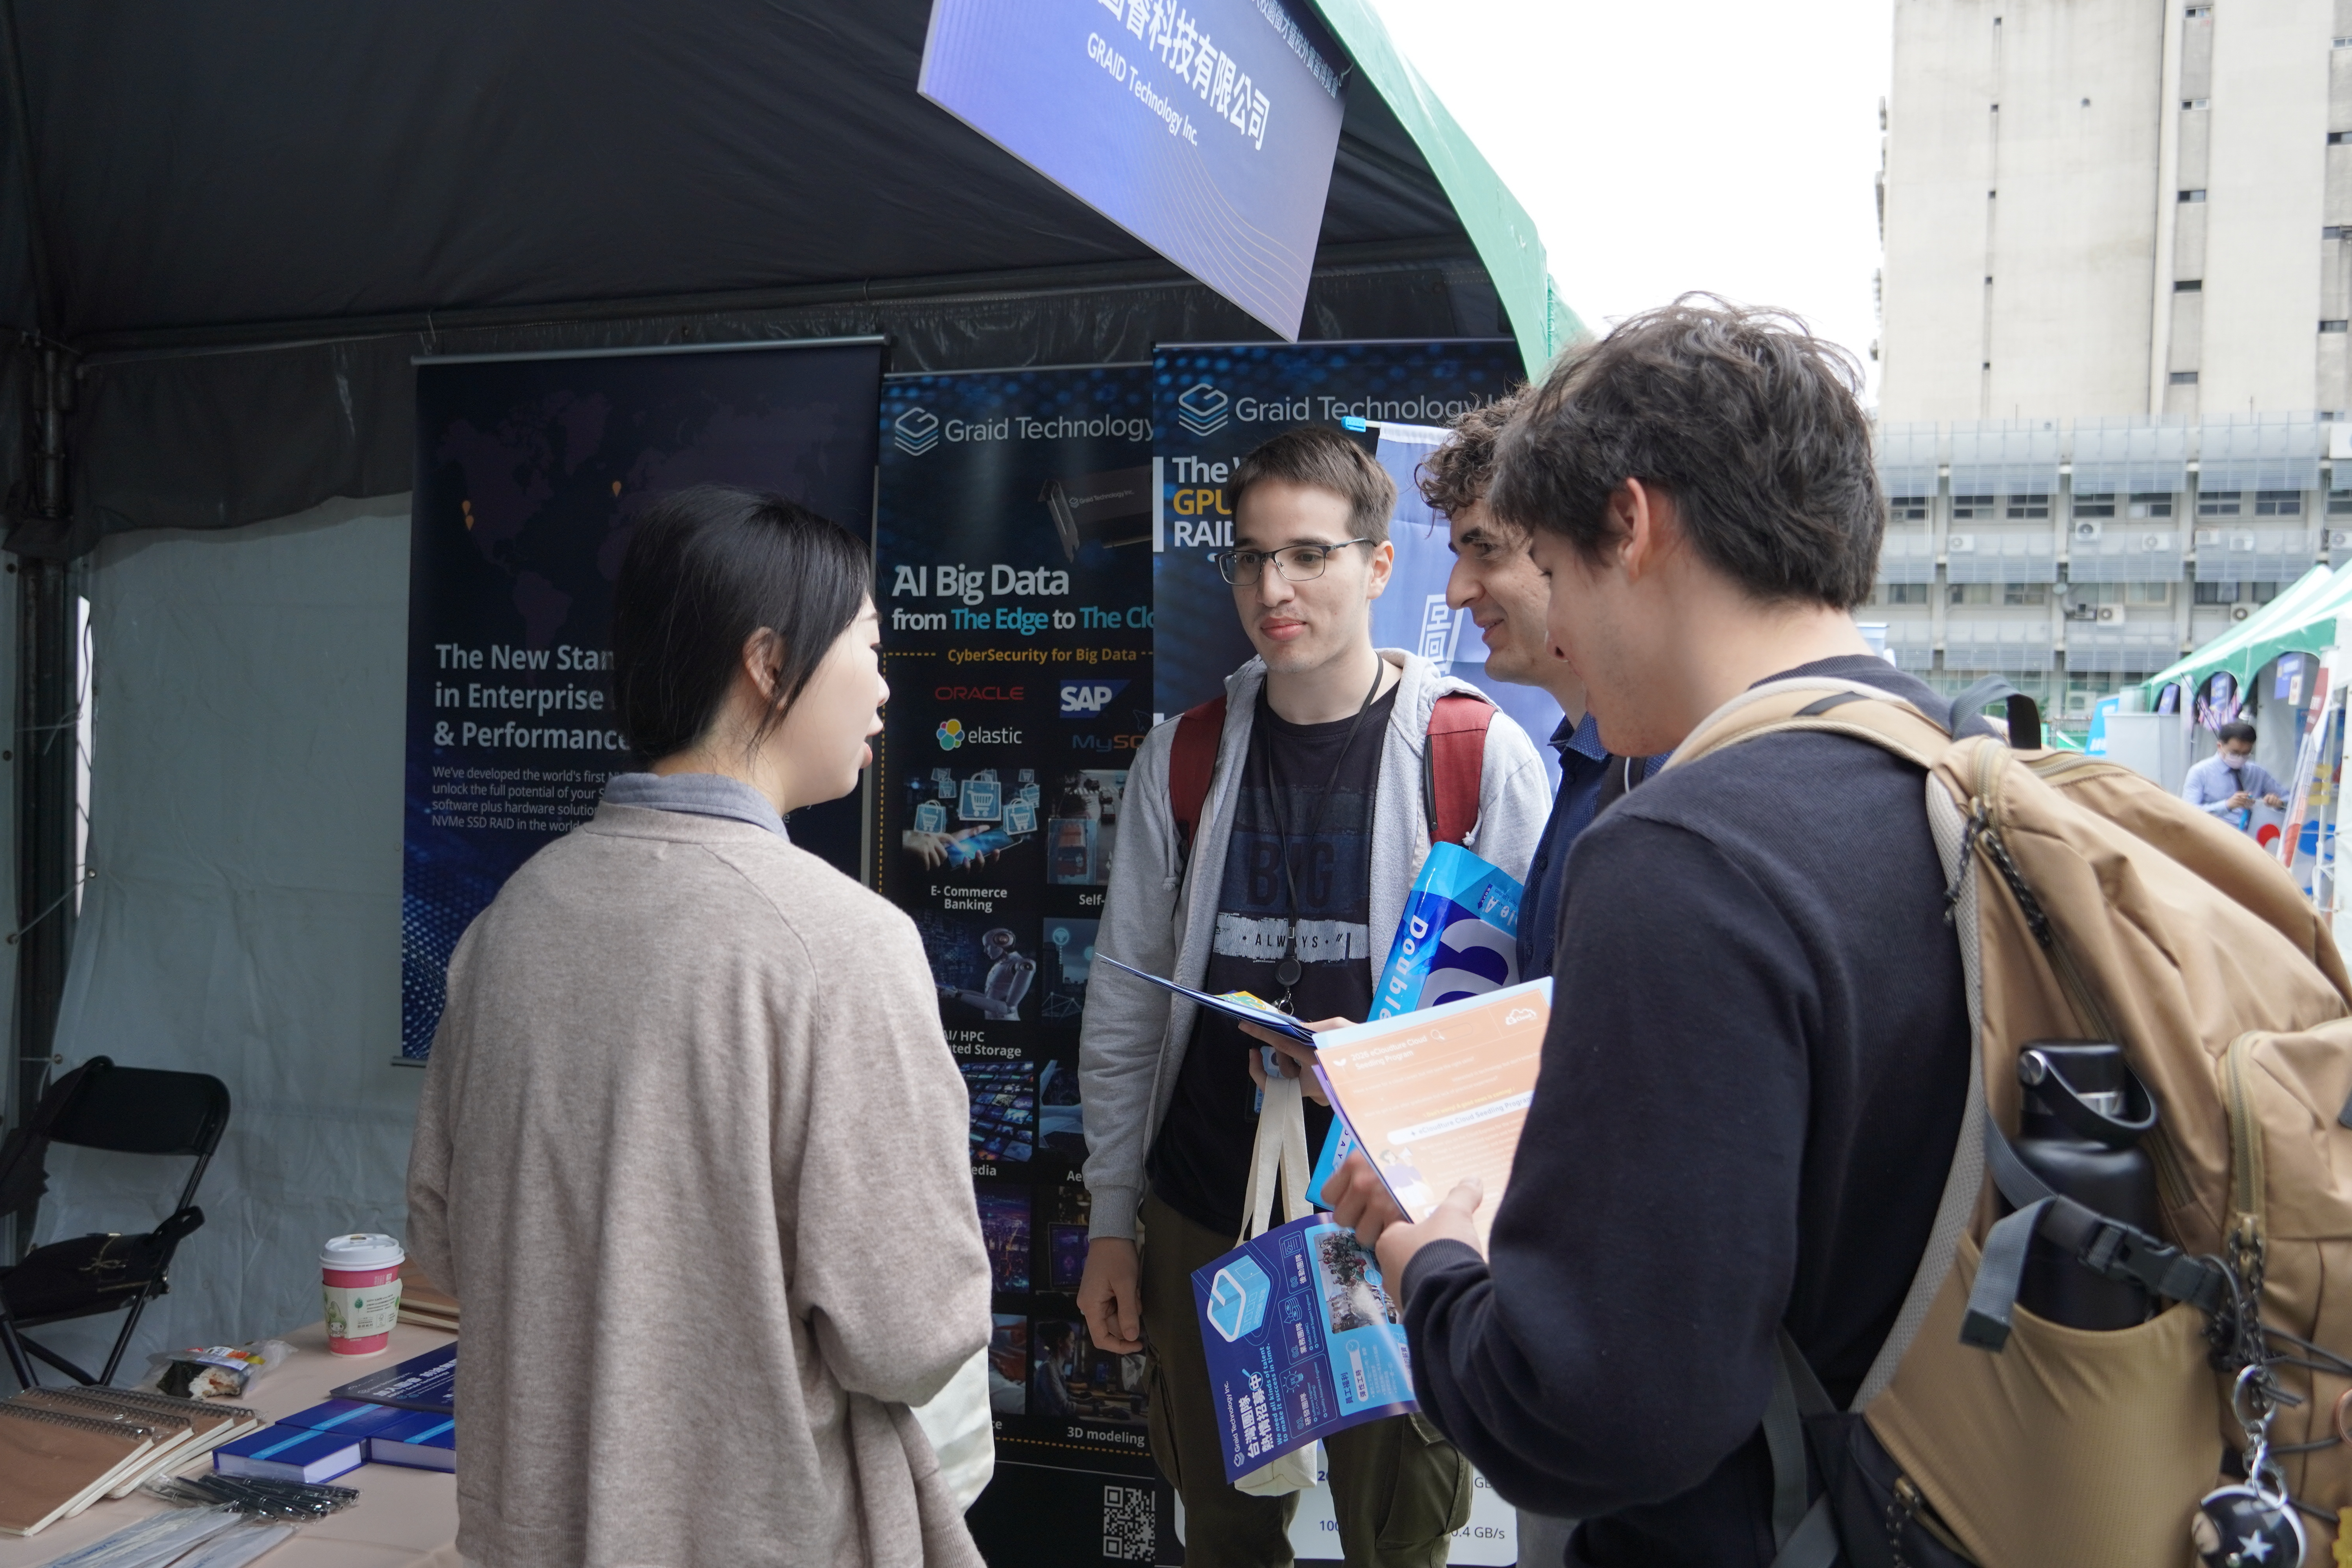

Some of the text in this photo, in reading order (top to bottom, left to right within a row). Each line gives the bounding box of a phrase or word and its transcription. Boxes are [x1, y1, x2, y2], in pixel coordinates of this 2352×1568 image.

[1087, 32, 1198, 146] GRAID Technology Inc.
[1236, 397, 1310, 422] Graid
[945, 415, 1153, 442] Graid Technology
[1172, 456, 1228, 483] The
[1094, 492, 1124, 501] Technology
[892, 564, 1069, 605] AI Big Data
[892, 608, 946, 630] from
[951, 608, 991, 629] The
[995, 608, 1048, 636] Edge
[1053, 610, 1076, 629] to
[1080, 606, 1121, 628] The
[435, 643, 483, 670] The
[491, 644, 550, 670] New
[948, 648, 1136, 665] CyberSecurity for Big Data
[435, 682, 604, 717] in Enterprise
[935, 686, 1024, 700] ORACLE
[1061, 686, 1112, 712] SAP
[434, 721, 455, 746] &
[968, 727, 1022, 744] elastic
[432, 767, 465, 779] We've
[467, 768, 520, 782] developed
[523, 768, 540, 780] the
[543, 770, 581, 783] world's
[583, 771, 605, 783] first
[433, 783, 468, 795] unlock
[470, 785, 487, 796] the
[490, 785, 505, 797] full
[509, 786, 554, 799] potential
[557, 787, 569, 799] of
[570, 789, 595, 802] your
[432, 800, 478, 811] software
[481, 801, 503, 814] plus
[505, 801, 554, 815] hardware
[433, 816, 465, 827] NVMe
[467, 817, 486, 829] SSD
[490, 817, 514, 829] RAID
[517, 818, 527, 829] in
[529, 818, 546, 831] the
[944, 886, 1008, 898] Commerce
[1481, 888, 1490, 903] COPY
[944, 899, 993, 913] Banking
[1379, 915, 1428, 1020] Double
[960, 1031, 984, 1042] HPC
[975, 1044, 1022, 1059] Storage
[1351, 1050, 1369, 1061] 2026
[1406, 1034, 1427, 1047] Cloud
[1355, 1051, 1414, 1070] Seedling Program
[1455, 1114, 1474, 1123] Cloud
[1475, 1103, 1505, 1118] Seedling
[971, 1165, 997, 1176] edia
[1290, 1276, 1298, 1287] 03
[1296, 1323, 1307, 1353] 業務團隊
[1259, 1347, 1268, 1369] talent
[1290, 1345, 1299, 1358] 02
[1271, 1373, 1280, 1401] success
[1341, 1372, 1353, 1403] 員工福利
[1355, 1370, 1366, 1397] 彈性工時
[1226, 1394, 1237, 1434] Technology
[1250, 1374, 1274, 1452] 熱情招募中
[1300, 1393, 1311, 1425] 研發團隊
[1238, 1394, 1261, 1458] 台灣團隊
[1296, 1416, 1304, 1430] 01
[1067, 1426, 1145, 1447] 3D modeling
[1276, 1433, 1282, 1445] We
[1283, 1433, 1288, 1442] to
[1474, 1528, 1506, 1540] GB/s
